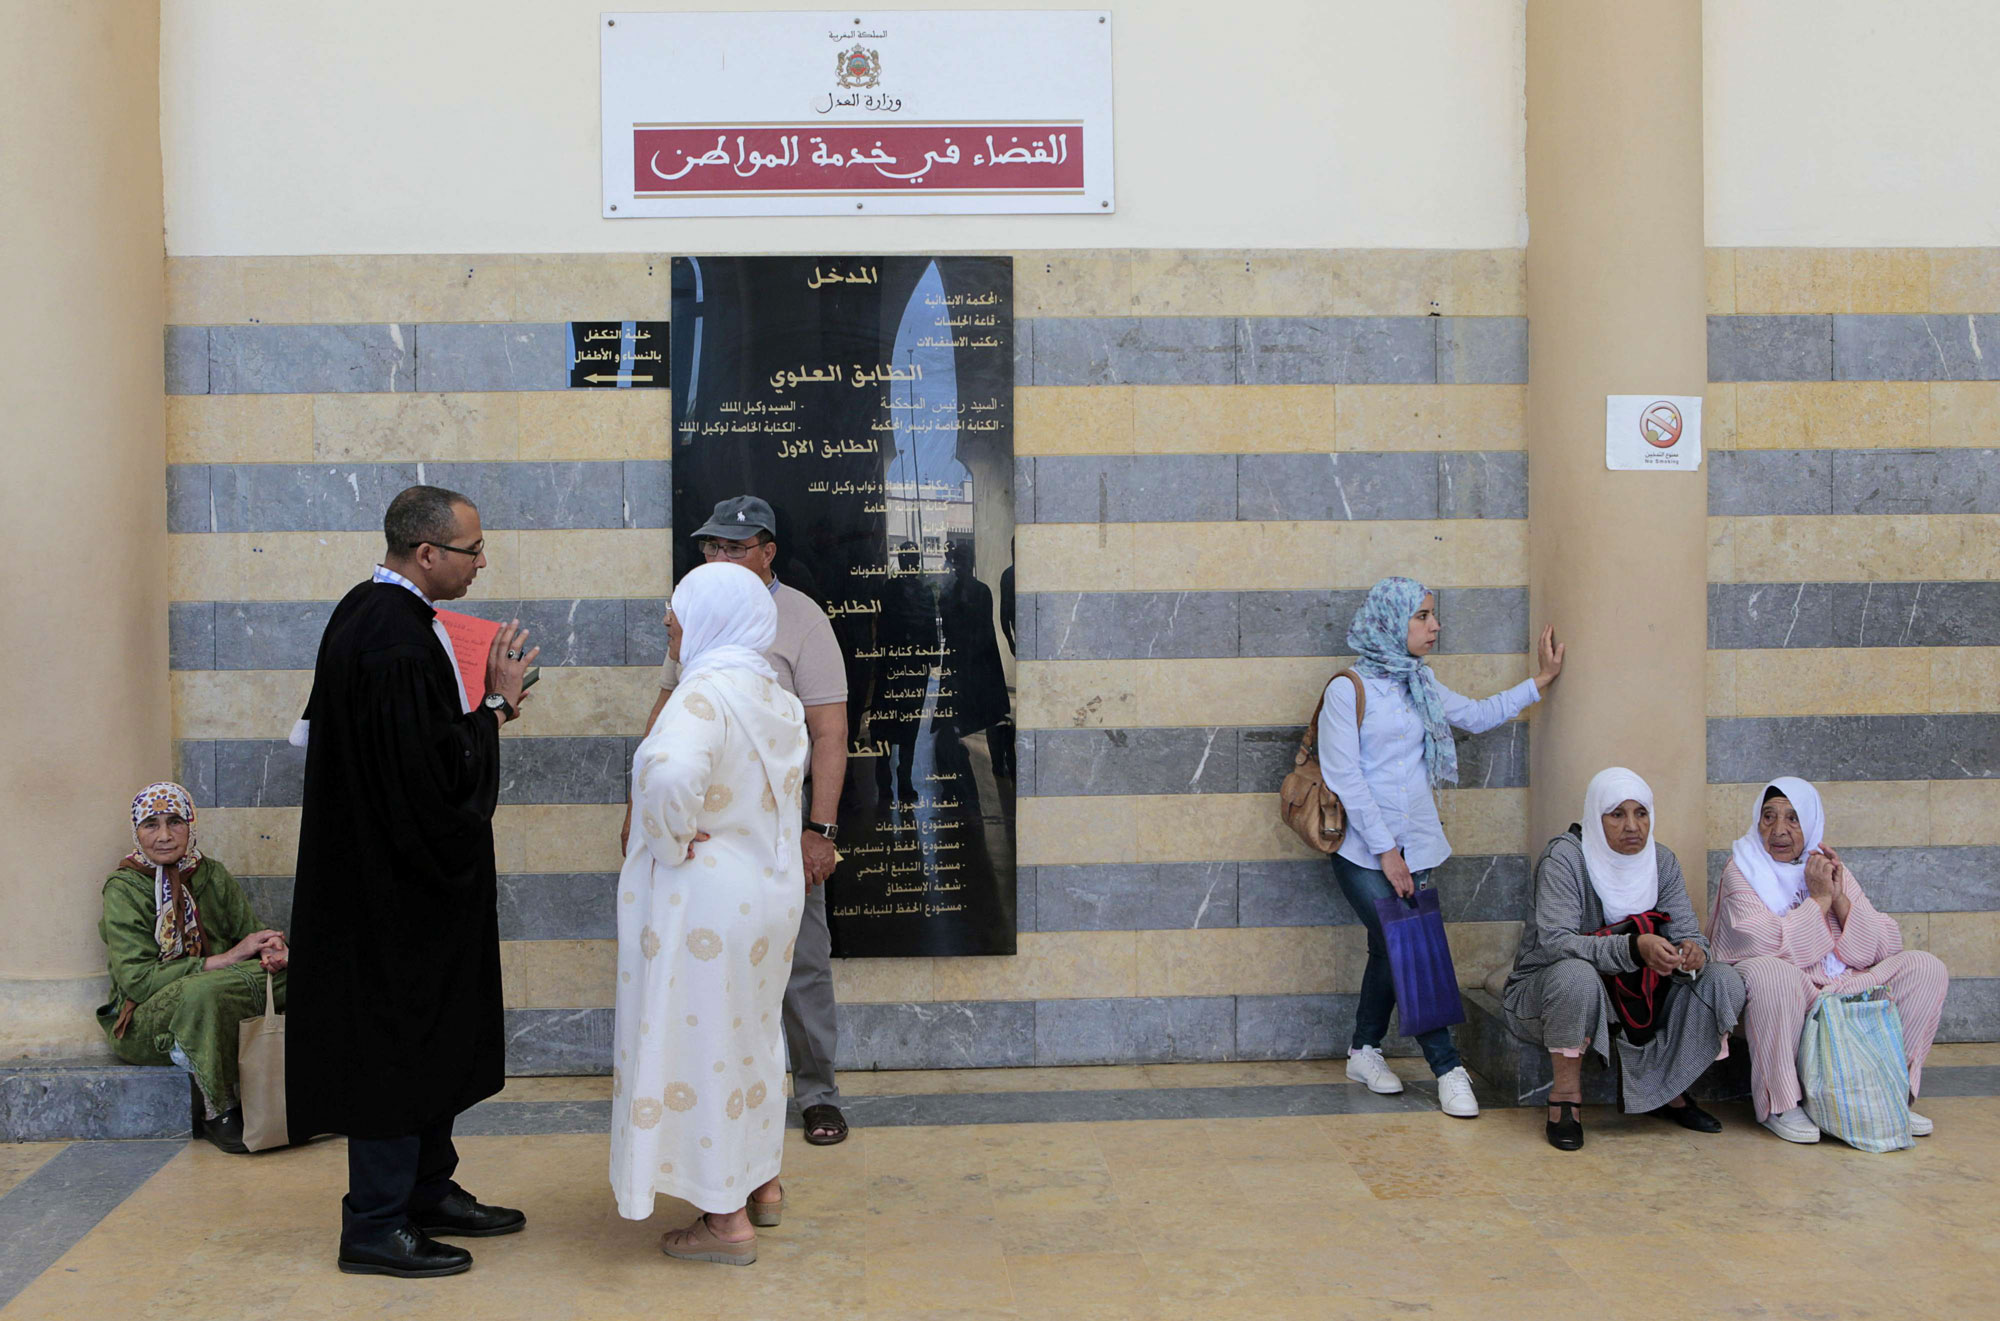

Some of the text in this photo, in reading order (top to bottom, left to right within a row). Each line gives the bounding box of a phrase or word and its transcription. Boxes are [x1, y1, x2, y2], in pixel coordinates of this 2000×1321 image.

[828, 30, 887, 42] المملكة المغربية
[815, 92, 902, 114] وزارة العدل
[650, 133, 1067, 184] القضاء في خدمة المواطن
[807, 265, 878, 289] المدخل
[924, 291, 998, 309] المحكمة الابتدائية
[934, 313, 995, 328] قاعة الجلسات
[583, 328, 652, 343] خلية التكفل
[916, 336, 998, 350] مكتب الاستقبالات
[574, 347, 662, 364] بالنساء و الأطفال
[769, 363, 923, 394] الطابق العلوي
[720, 401, 796, 416] السيد وكيل الملك
[880, 396, 998, 414] السيد رئيس المحكمة
[678, 421, 795, 436] الكتابة الخاصة لوكيل الملك
[871, 417, 999, 434] الكتابة الخاصة لرئيس المحكمة
[777, 439, 878, 458] الطابق الاول
[808, 481, 829, 492] الملك
[832, 480, 854, 494] وكيل
[856, 480, 876, 494] نواب
[864, 501, 892, 513] العامة
[850, 564, 890, 578] العقوبات
[825, 599, 882, 619] الطابق
[854, 644, 951, 661] مصلحة كتابة الضبط
[886, 664, 928, 680] المحامين
[884, 686, 953, 702] مكتب الاعلاميات
[864, 706, 953, 728] قاعة التكوين الاعلامي
[925, 773, 957, 784] مسجد
[931, 795, 959, 812] شعبة
[875, 820, 959, 834] مستودع المطبوعات
[853, 841, 884, 856] تسليم
[893, 840, 920, 852] الحفظ
[922, 840, 960, 856] مستودع
[856, 860, 960, 881] مستودع التبليغ الجنحي
[934, 878, 961, 895] شعبة
[833, 901, 962, 918] مستودع الحفظ للنيابة العامة
